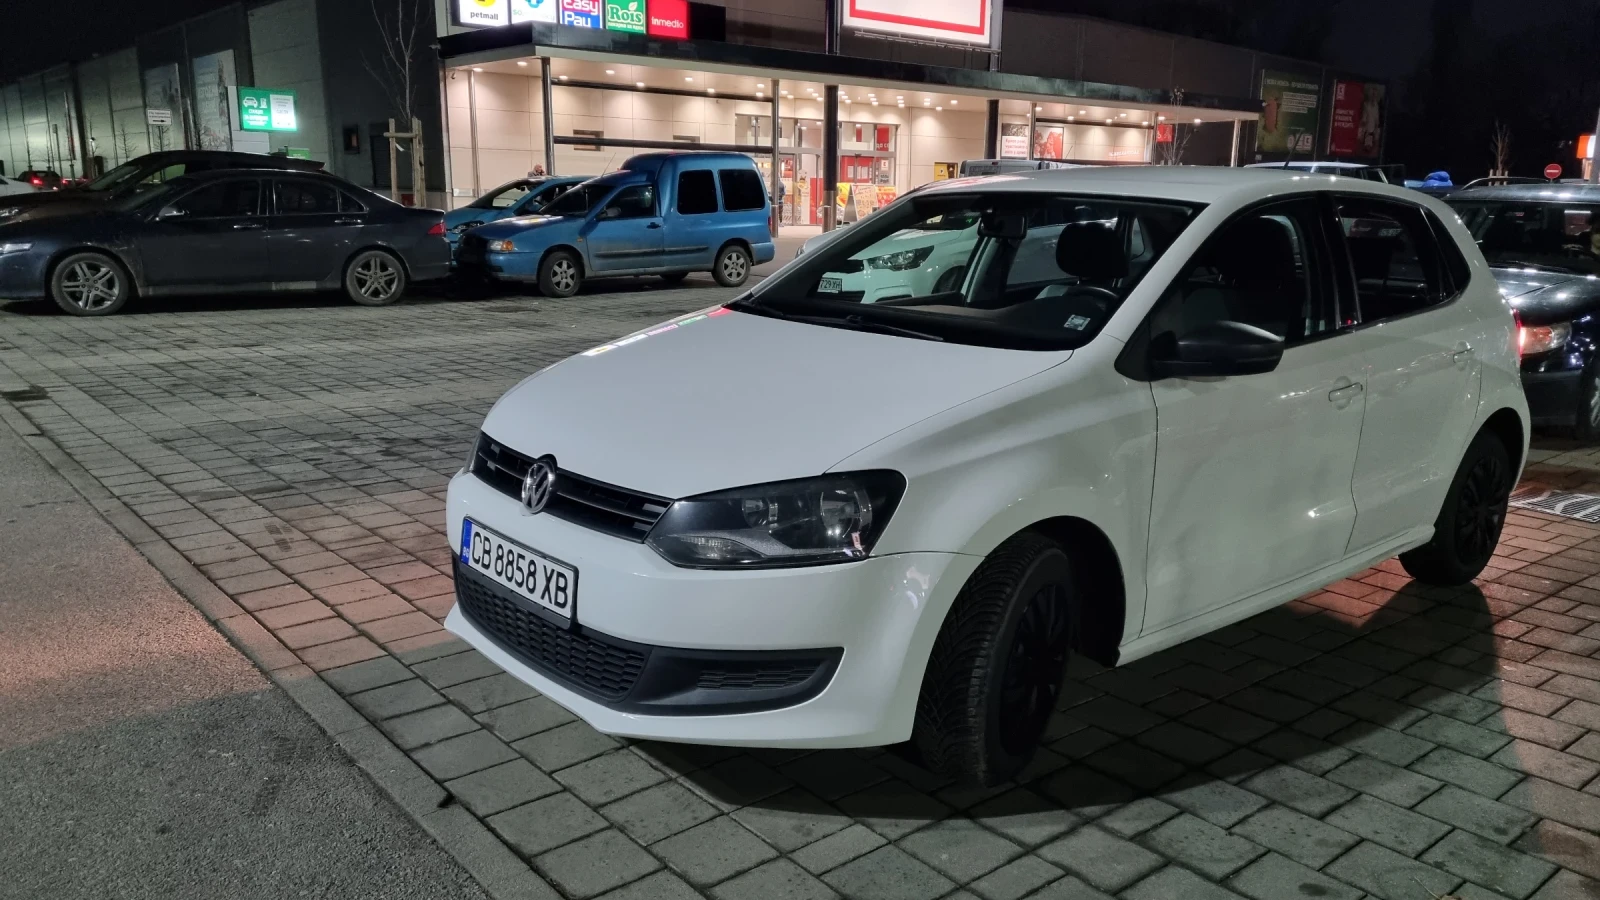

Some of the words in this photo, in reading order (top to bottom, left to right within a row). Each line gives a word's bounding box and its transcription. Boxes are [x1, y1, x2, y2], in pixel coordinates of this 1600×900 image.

[470, 11, 499, 21] petmall
[608, 4, 643, 24] Rois
[651, 16, 684, 28] inmedio
[472, 531, 492, 570] CB
[494, 543, 537, 594] 8858
[540, 564, 568, 609] XB
